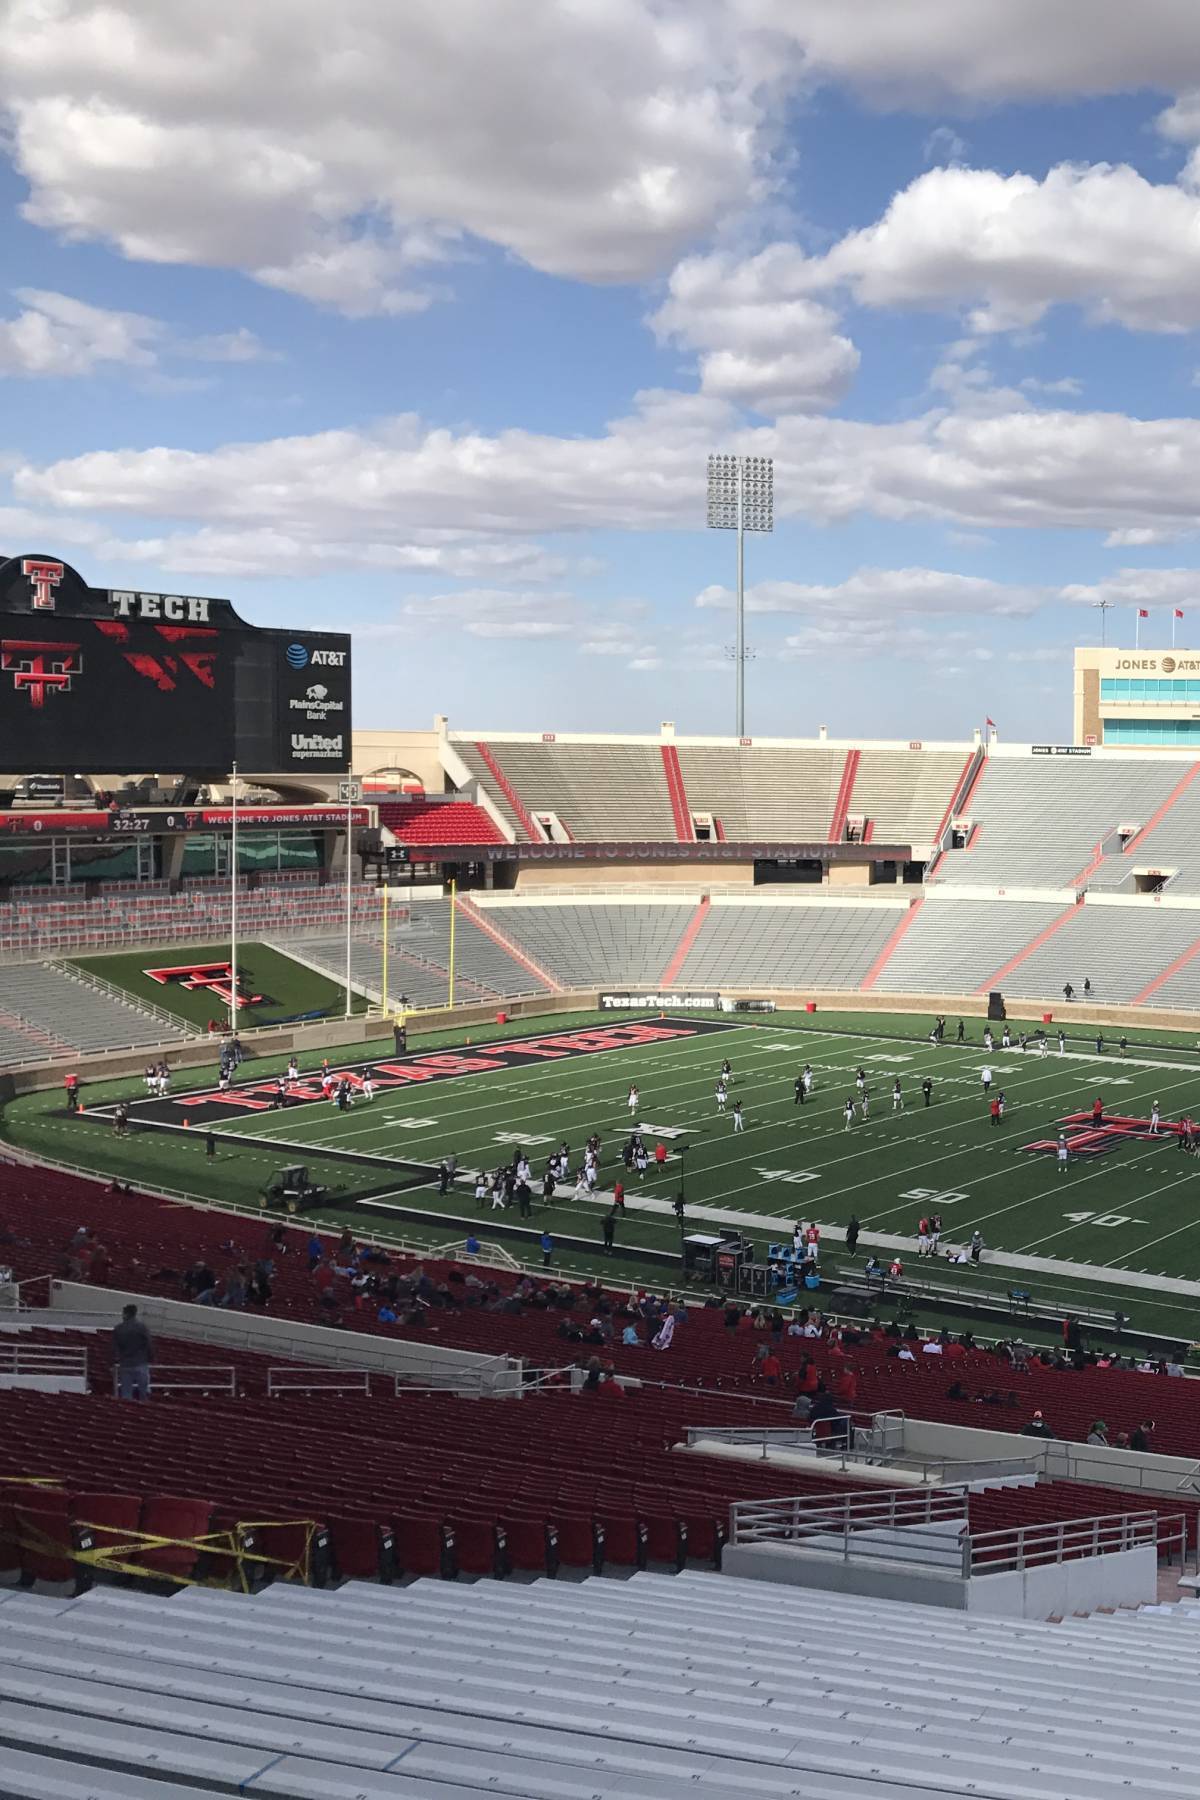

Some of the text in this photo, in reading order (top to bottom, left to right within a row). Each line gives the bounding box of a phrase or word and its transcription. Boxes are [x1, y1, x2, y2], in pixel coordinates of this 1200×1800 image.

[112, 591, 209, 622] TECH
[311, 650, 346, 666] AT&T
[1115, 659, 1157, 670] JONES
[289, 699, 343, 711] PlainsCapital
[306, 710, 327, 720] Bank
[291, 734, 343, 750] United
[291, 750, 343, 760] supermarkets
[113, 819, 149, 831] 32:27
[257, 815, 269, 823] TO
[271, 815, 300, 823] JONES
[325, 813, 362, 822] STADUM
[486, 847, 585, 860] WELCOME
[594, 846, 618, 859] TO
[626, 846, 690, 859] JONES
[751, 846, 837, 859] STADIUM
[603, 995, 714, 1008] TexasTech.com
[481, 1025, 698, 1058] TECH
[759, 1169, 822, 1184] 40
[897, 1187, 971, 1204] 50
[1062, 1211, 1132, 1227] 40
